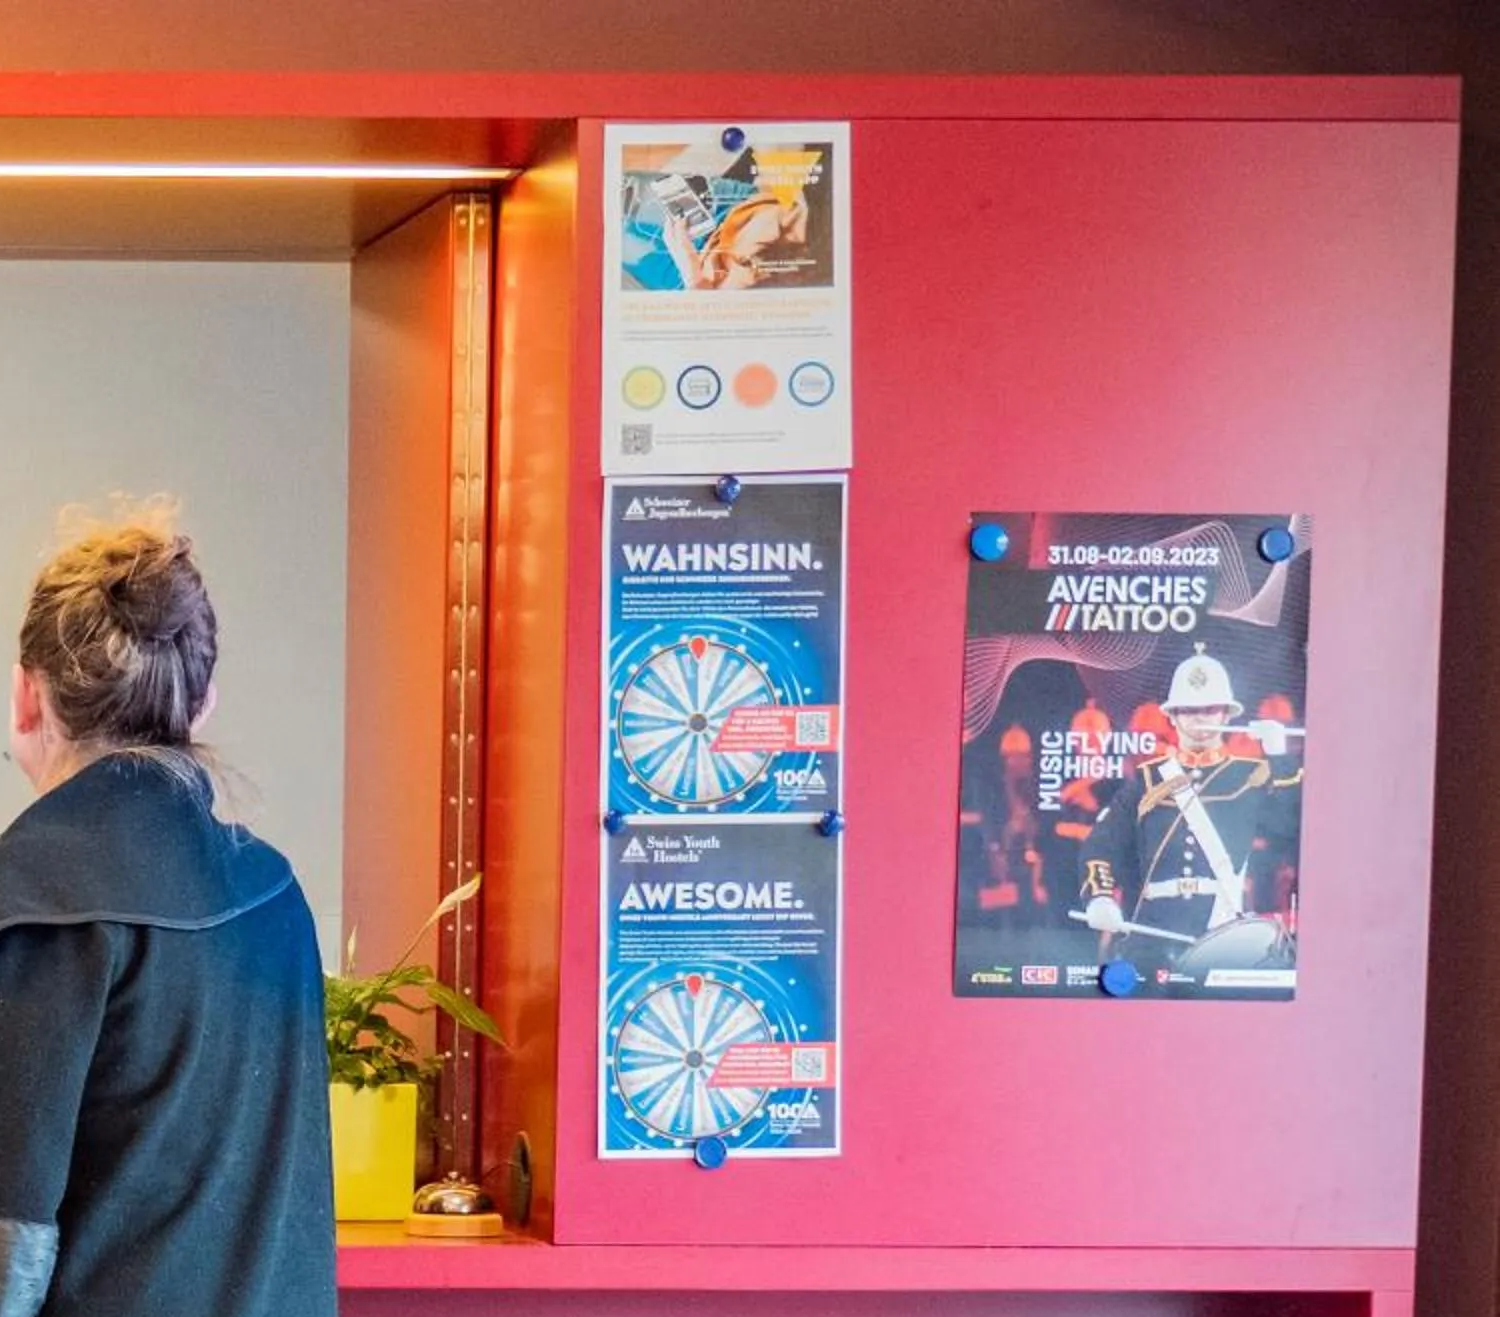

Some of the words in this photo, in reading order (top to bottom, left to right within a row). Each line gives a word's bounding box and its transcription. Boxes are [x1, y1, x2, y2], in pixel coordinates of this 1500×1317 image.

[621, 543, 824, 572] WAHNSINN.
[1047, 575, 1208, 605] AVENCHES
[1065, 731, 1157, 755] FLYING
[1038, 731, 1064, 811] MUSIC
[1064, 756, 1124, 779] HIGH
[646, 836, 681, 849] Swiss
[684, 835, 721, 849] Youth
[619, 881, 805, 911] AWESOME.
